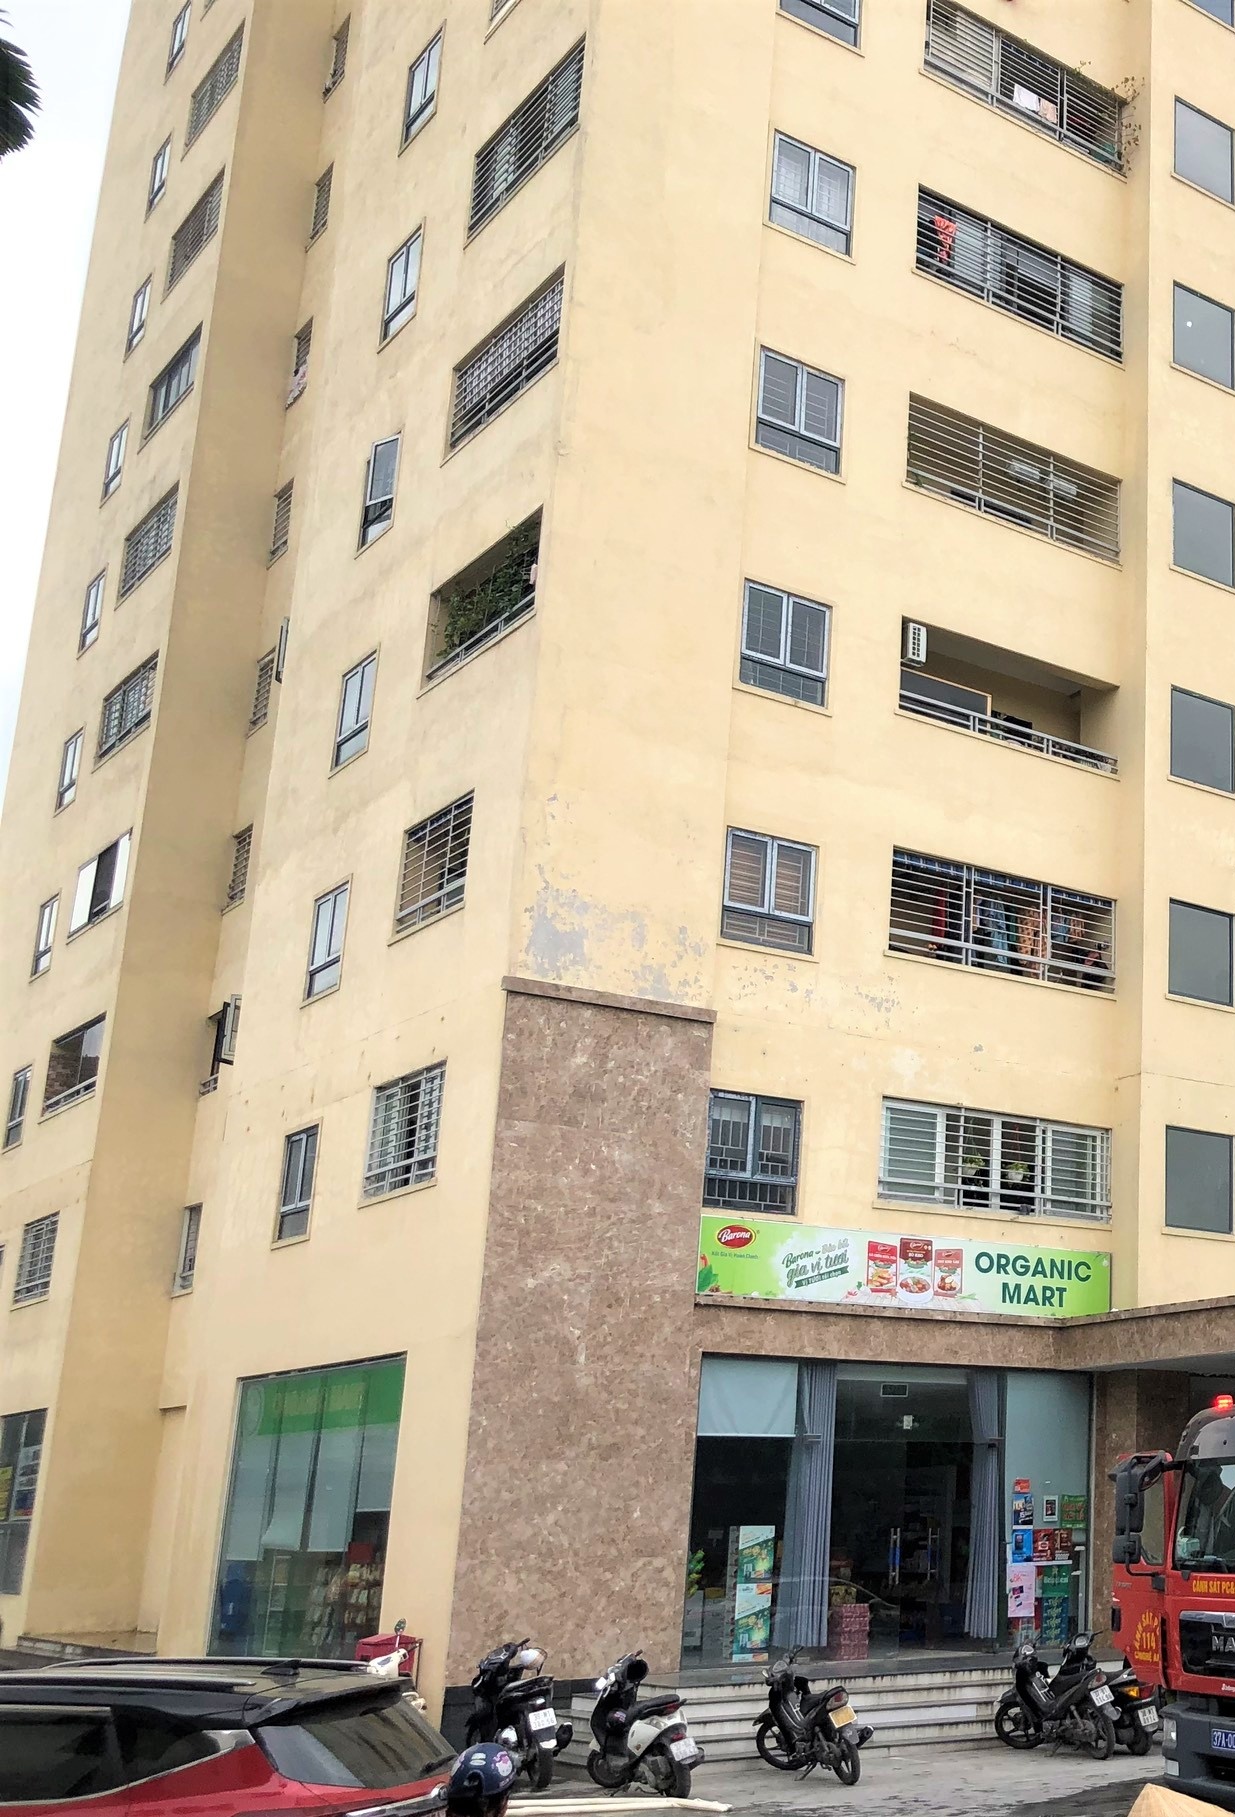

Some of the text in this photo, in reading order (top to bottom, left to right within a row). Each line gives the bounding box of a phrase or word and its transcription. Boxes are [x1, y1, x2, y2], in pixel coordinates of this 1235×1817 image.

[718, 1229, 751, 1243] Barona
[782, 1250, 814, 1268] Barona
[975, 1251, 1092, 1282] ORGANIC
[786, 1259, 809, 1289] gia
[1002, 1282, 1067, 1308] MART
[1192, 1578, 1208, 1593] CẢNH
[1208, 1580, 1221, 1594] SÁT
[1142, 1632, 1156, 1650] 114
